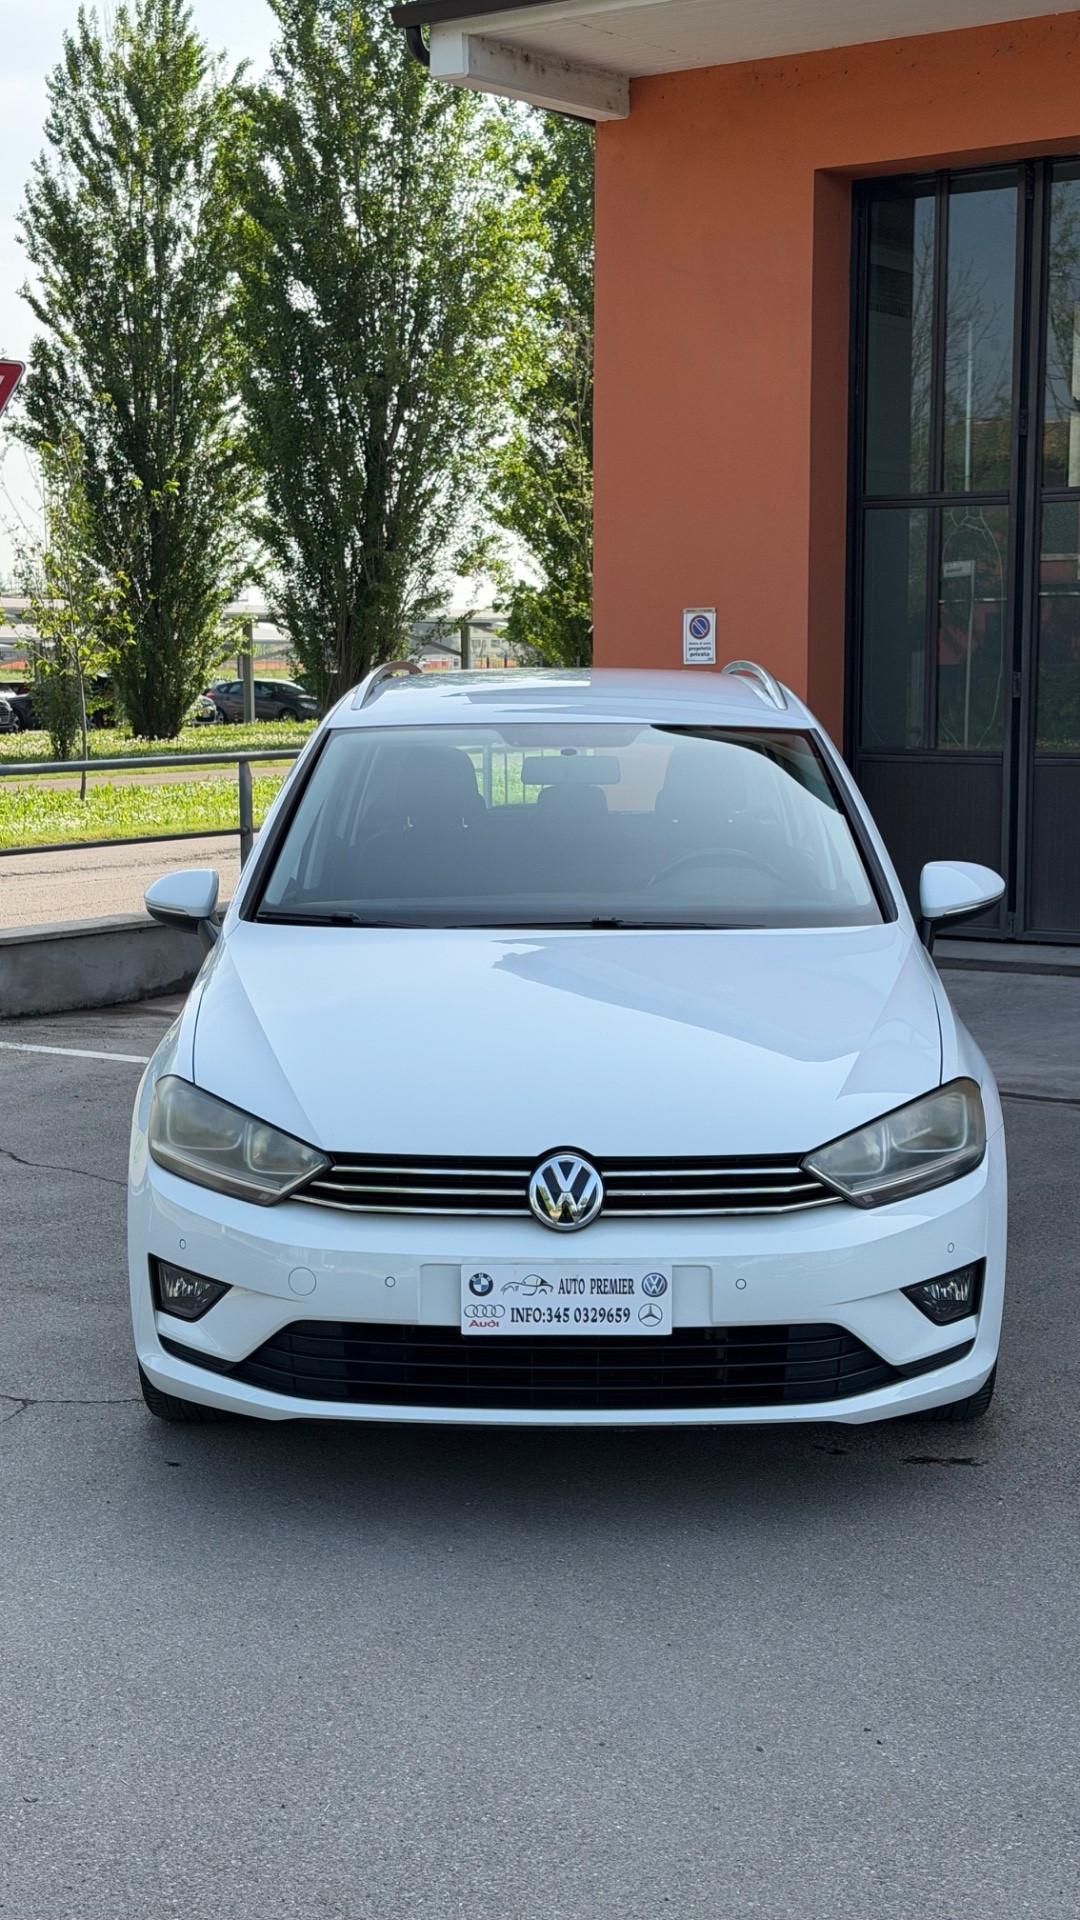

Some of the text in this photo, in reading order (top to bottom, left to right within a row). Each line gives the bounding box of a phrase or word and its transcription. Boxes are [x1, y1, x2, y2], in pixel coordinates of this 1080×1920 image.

[531, 1157, 602, 1227] VW
[558, 1278, 634, 1295] AUTO PREMIER
[643, 1274, 666, 1296] VW
[469, 1319, 500, 1328] Audi
[510, 1307, 631, 1323] INFO:345 0329659
